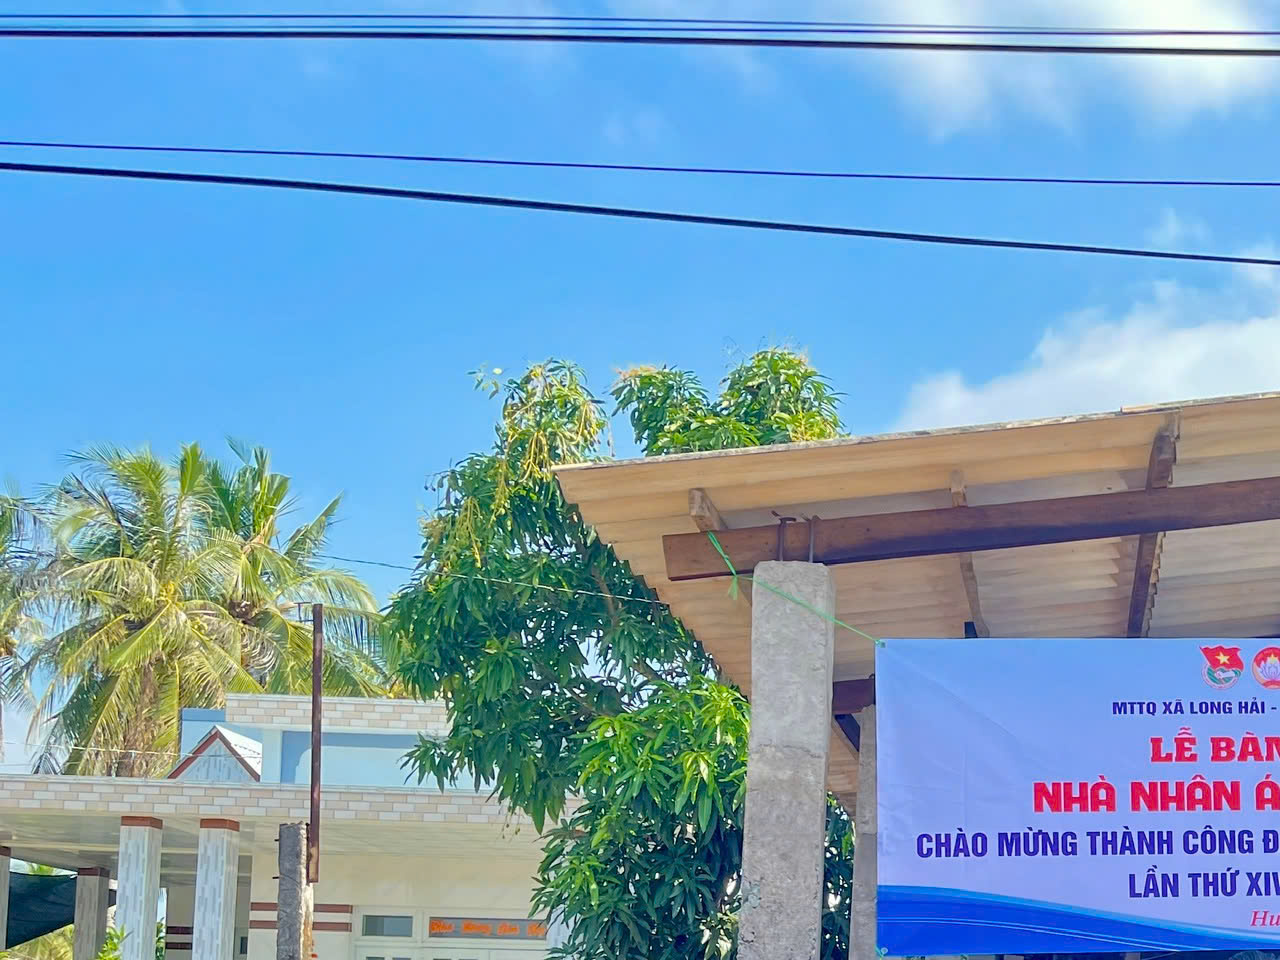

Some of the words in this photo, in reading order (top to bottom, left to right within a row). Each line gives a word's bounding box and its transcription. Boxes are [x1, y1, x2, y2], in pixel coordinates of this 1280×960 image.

[1112, 701, 1157, 716] MTTQ
[1162, 699, 1185, 715] XÃ
[1189, 701, 1233, 715] LONG
[1238, 696, 1266, 715] HẢI
[1150, 726, 1198, 763] LỄ
[1033, 775, 1117, 813] NHÀ
[1130, 774, 1241, 813] NHÂN
[916, 827, 988, 859] CHÀO
[997, 826, 1078, 857] MỪNG
[1086, 825, 1174, 856] THÀNH
[1182, 825, 1254, 855] CÔNG
[1128, 865, 1180, 899] LẦN
[1187, 866, 1240, 898] THỨ
